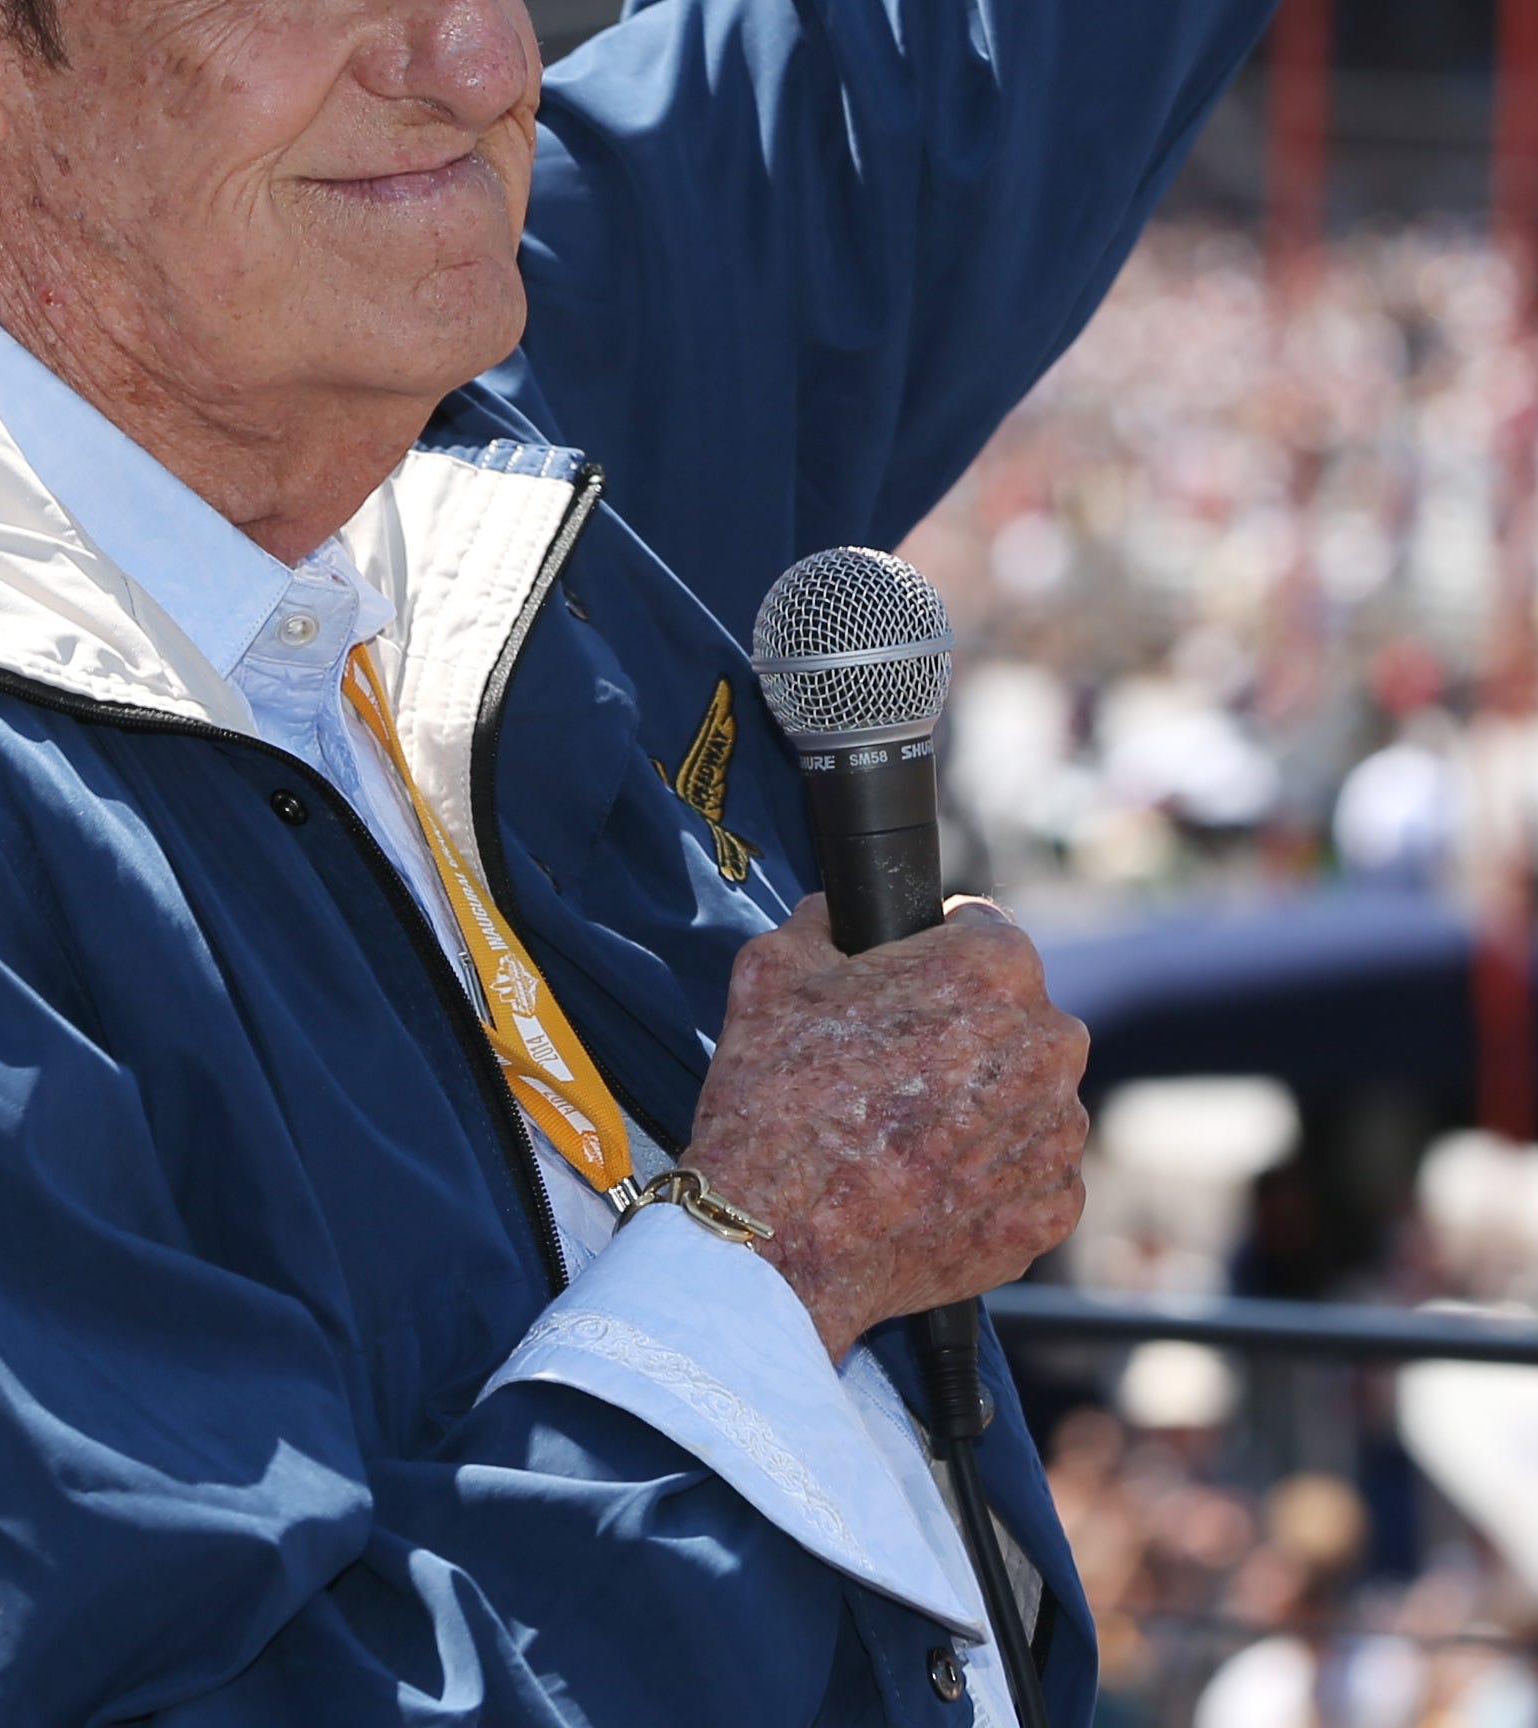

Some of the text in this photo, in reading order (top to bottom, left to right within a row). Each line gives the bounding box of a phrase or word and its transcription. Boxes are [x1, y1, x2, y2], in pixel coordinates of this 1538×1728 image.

[849, 750, 888, 767] SM58
[455, 873, 509, 951] INAUGURAL
[525, 1034, 559, 1066] 2014
